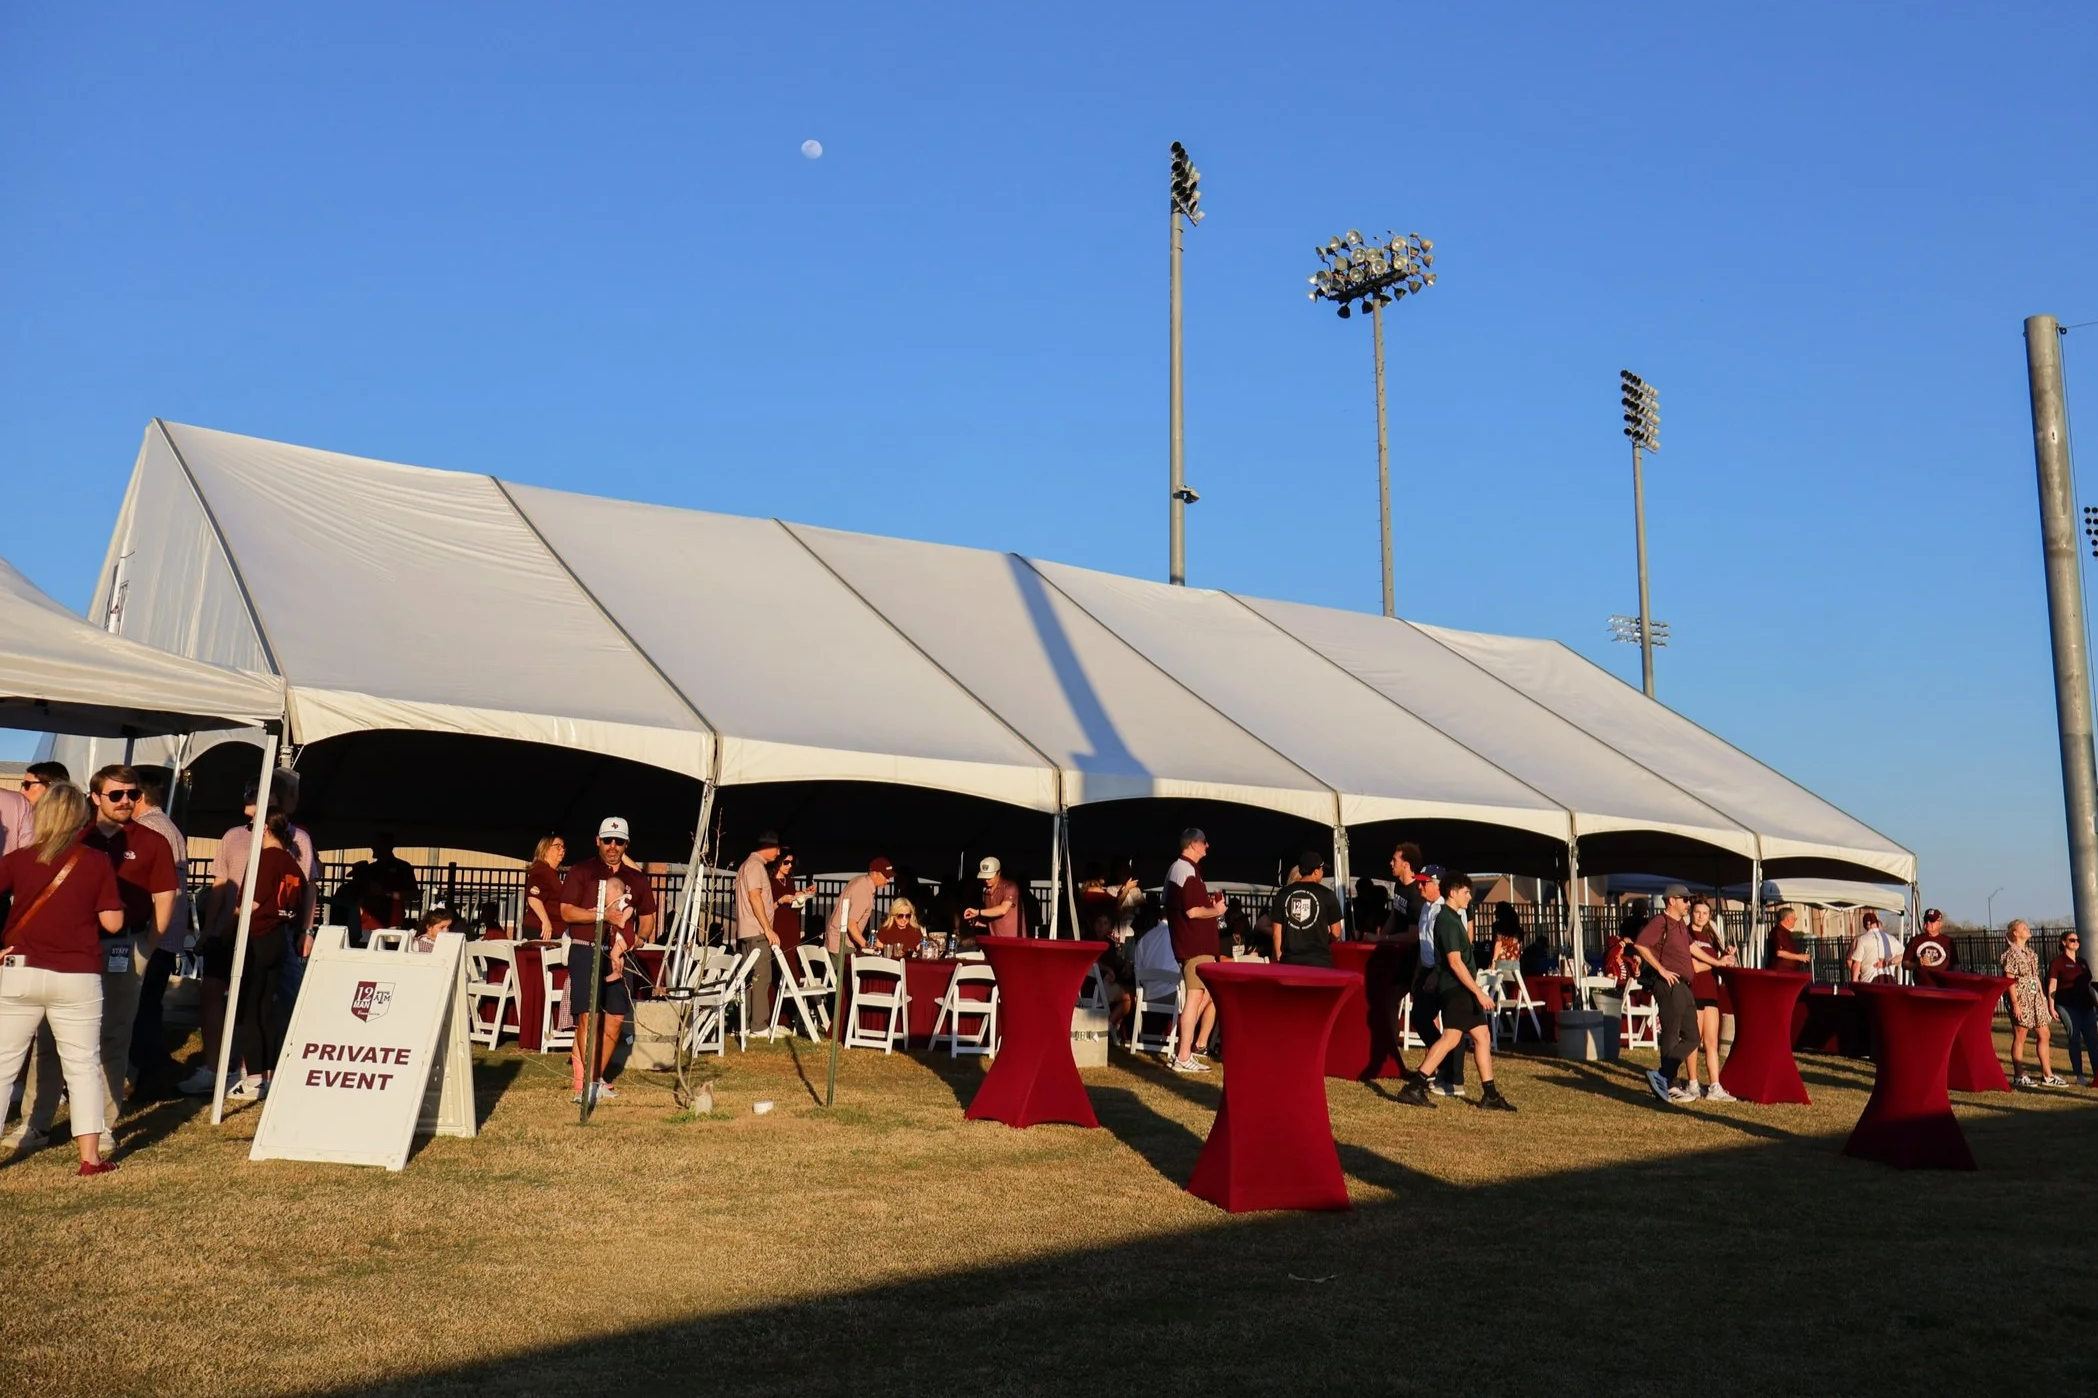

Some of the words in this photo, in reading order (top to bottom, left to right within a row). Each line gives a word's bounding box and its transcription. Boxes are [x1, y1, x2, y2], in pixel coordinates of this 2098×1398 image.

[356, 986, 373, 1001] 12
[302, 1043, 411, 1065] PRIVATE
[305, 1070, 393, 1090] EVENT
